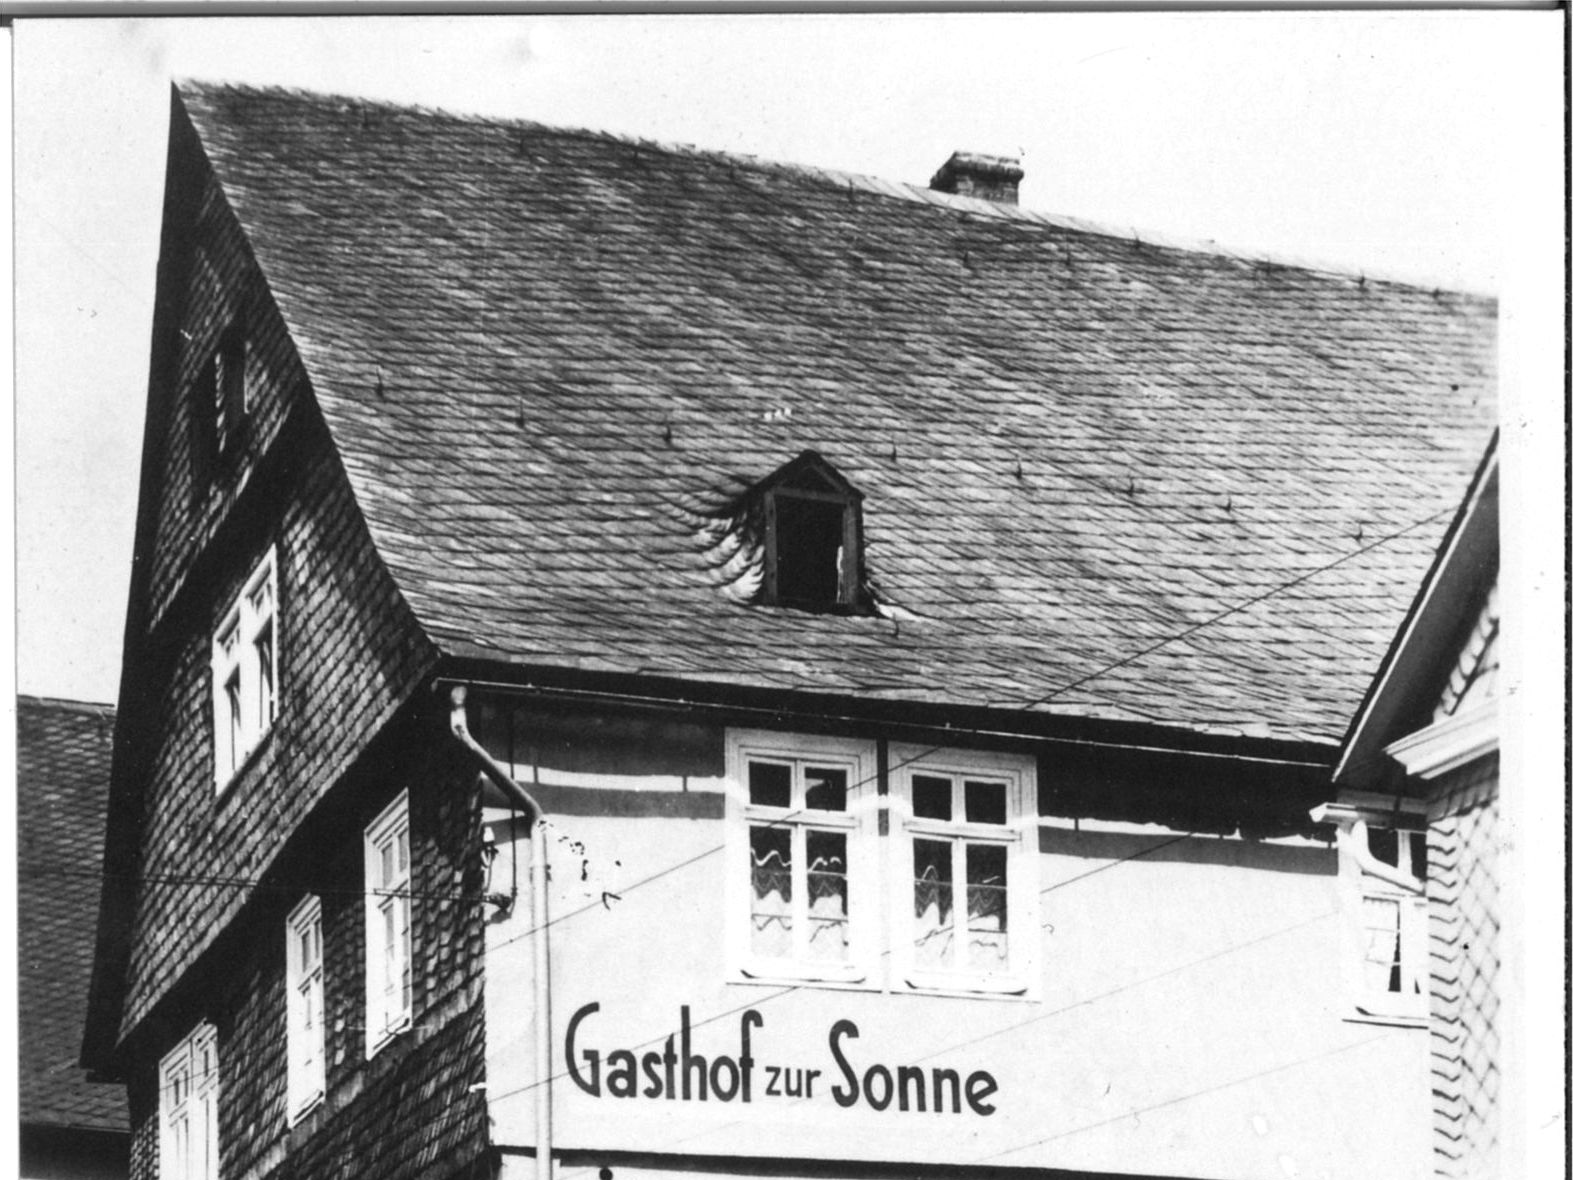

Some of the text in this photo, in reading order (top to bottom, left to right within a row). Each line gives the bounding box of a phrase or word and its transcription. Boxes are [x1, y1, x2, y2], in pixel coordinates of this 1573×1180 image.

[565, 1002, 998, 1116] Gasthof zur Sonne
